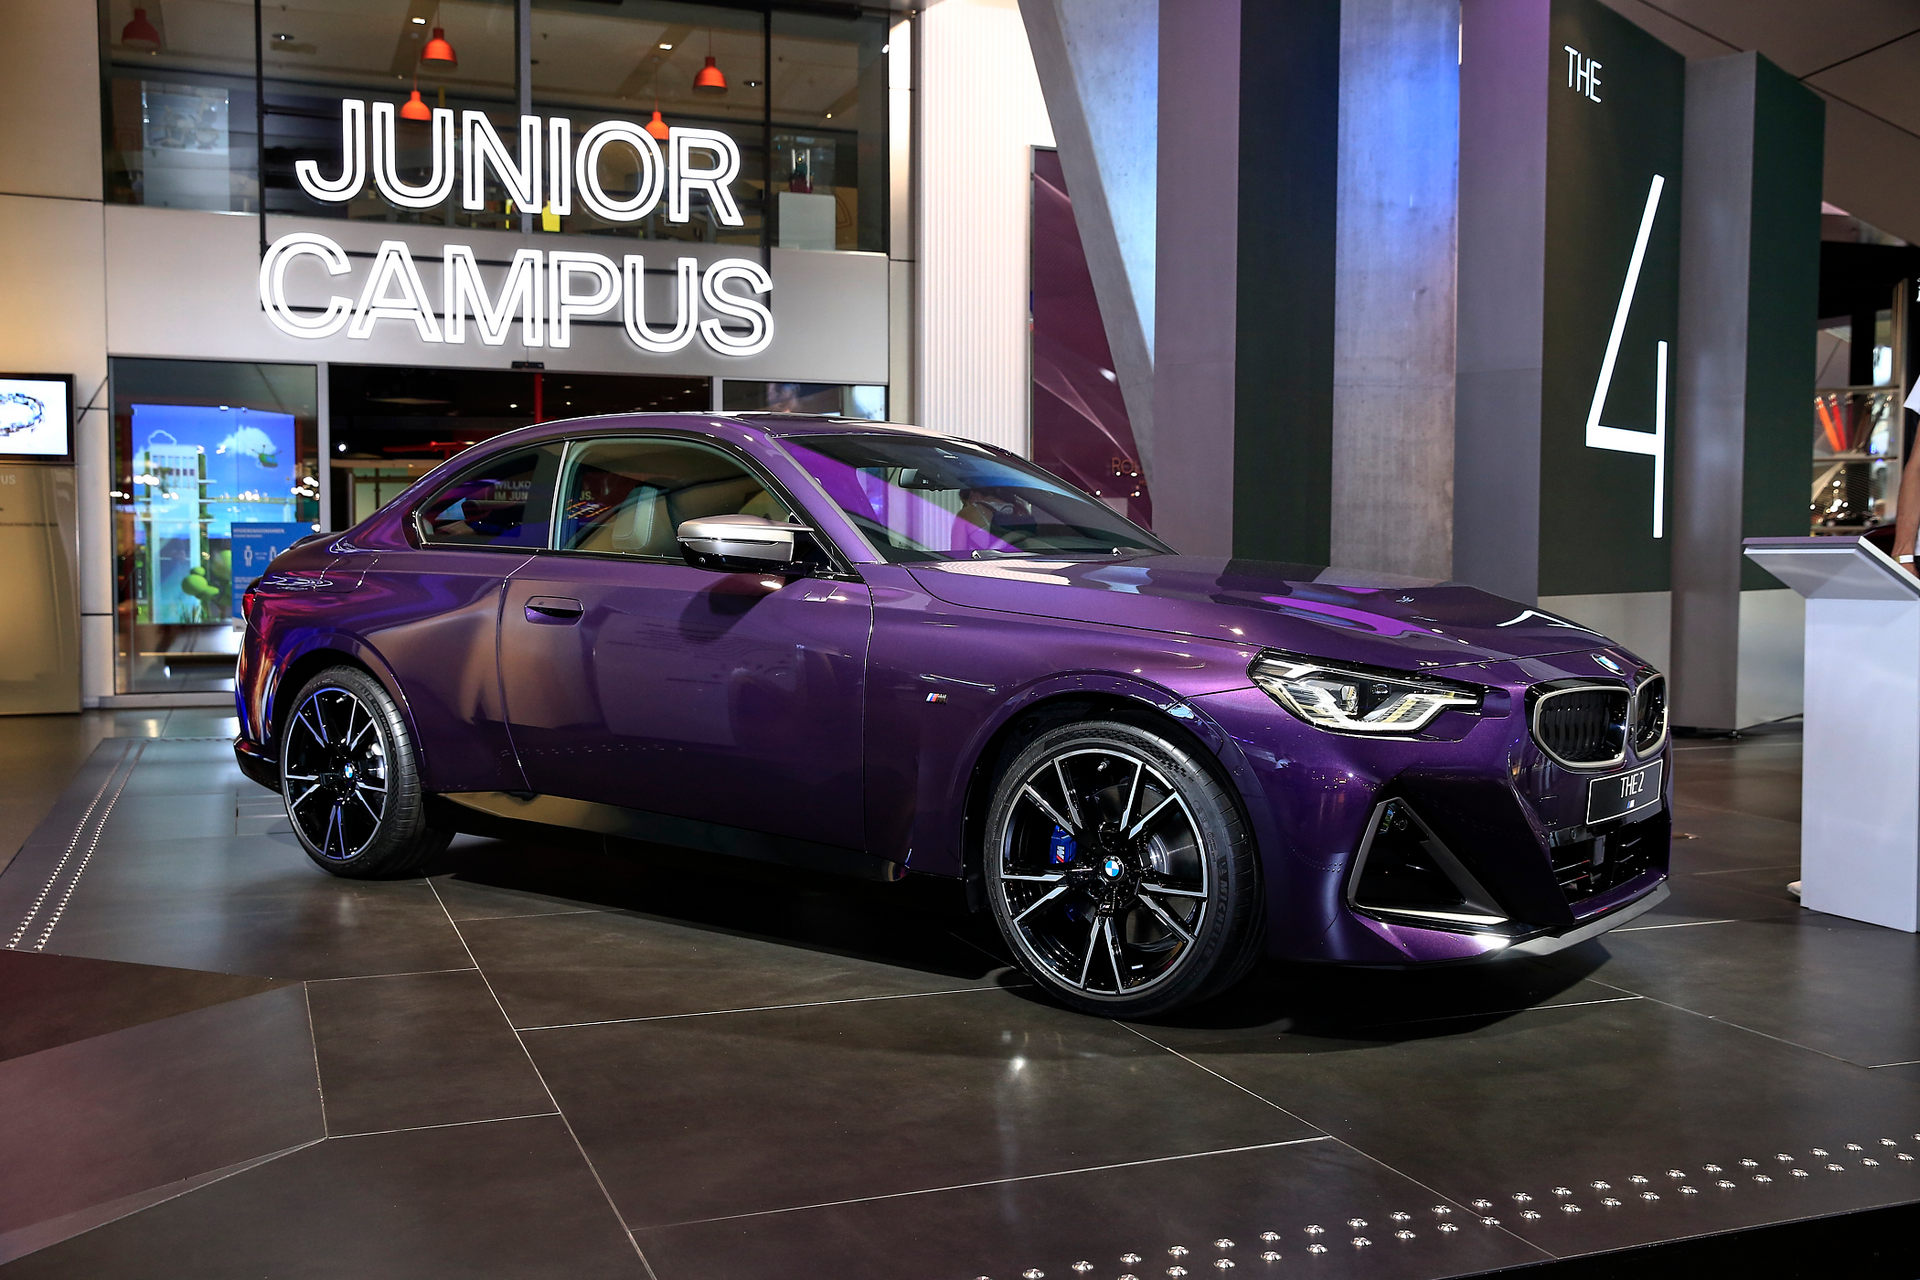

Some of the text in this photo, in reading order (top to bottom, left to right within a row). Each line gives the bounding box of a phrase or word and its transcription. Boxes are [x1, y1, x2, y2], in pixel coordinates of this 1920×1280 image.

[1564, 45, 1602, 103] THE
[295, 98, 744, 226] JUNIOR
[259, 232, 775, 357] CAMPUS
[1586, 174, 1668, 539] 4
